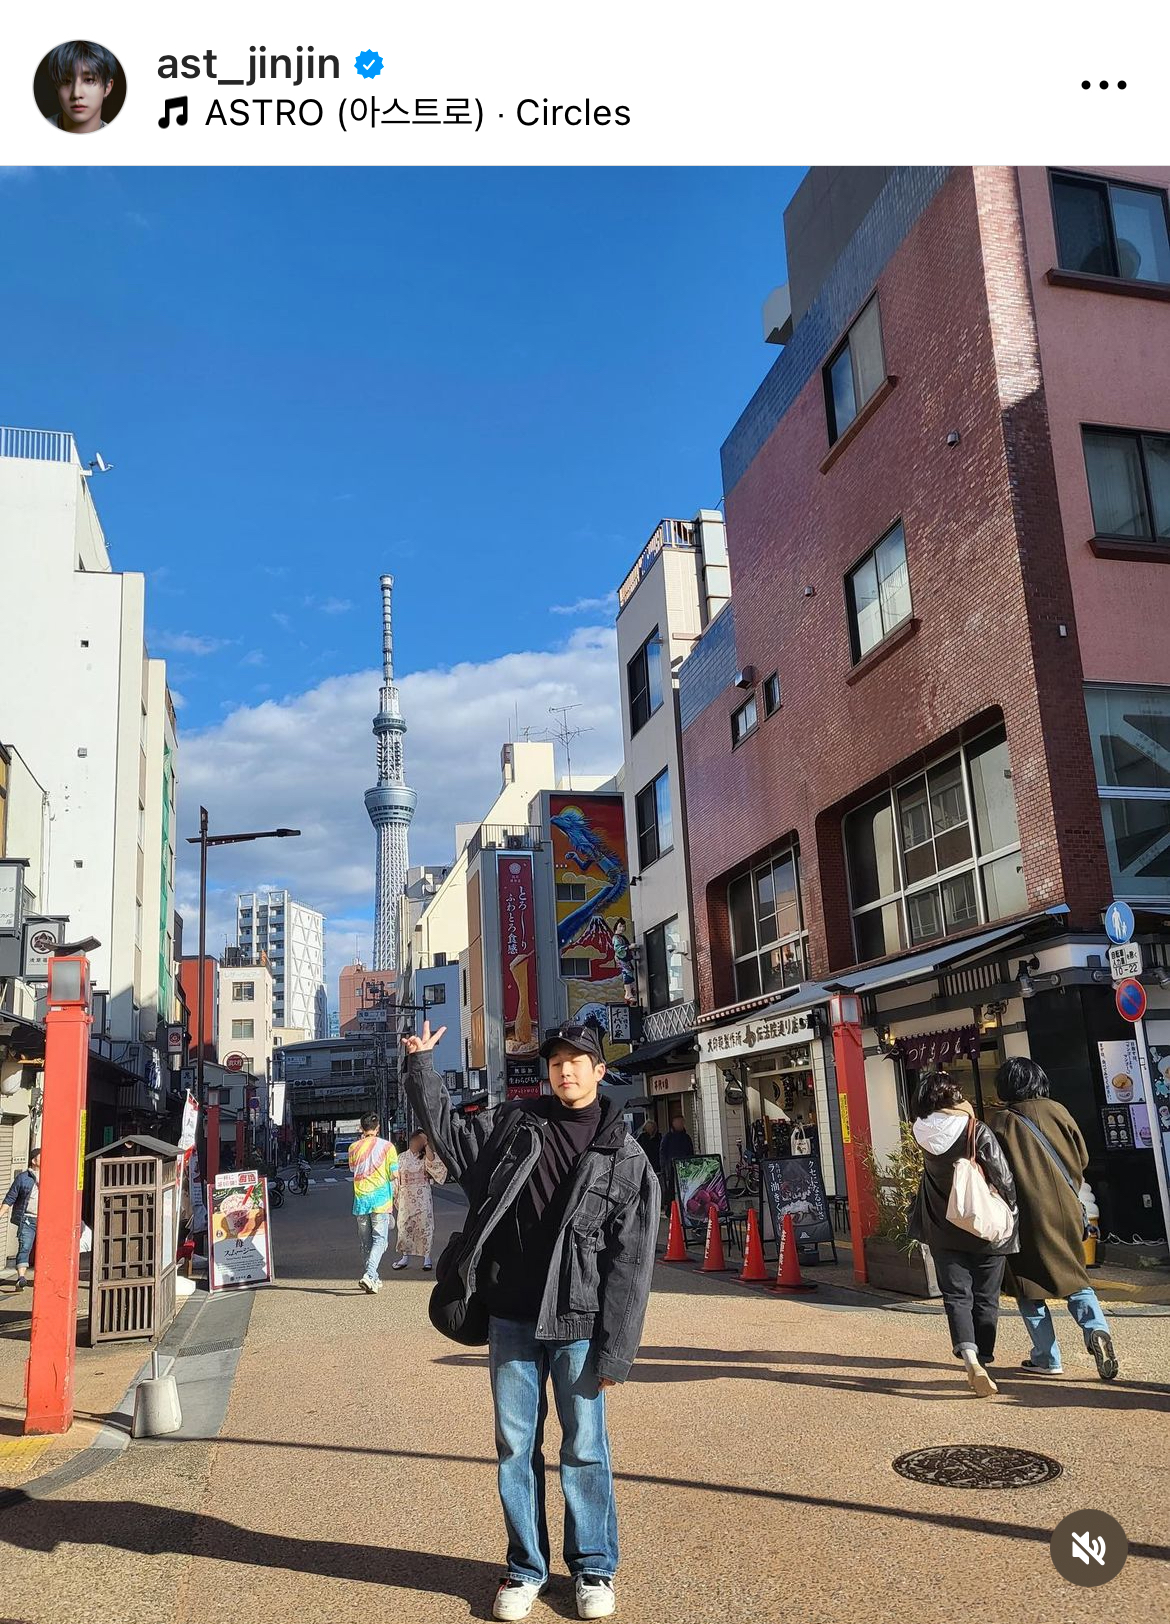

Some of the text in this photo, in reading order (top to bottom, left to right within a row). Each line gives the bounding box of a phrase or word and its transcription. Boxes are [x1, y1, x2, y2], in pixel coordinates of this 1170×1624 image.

[506, 893, 518, 955] ふわとろ食感
[1115, 963, 1138, 976] 10-22
